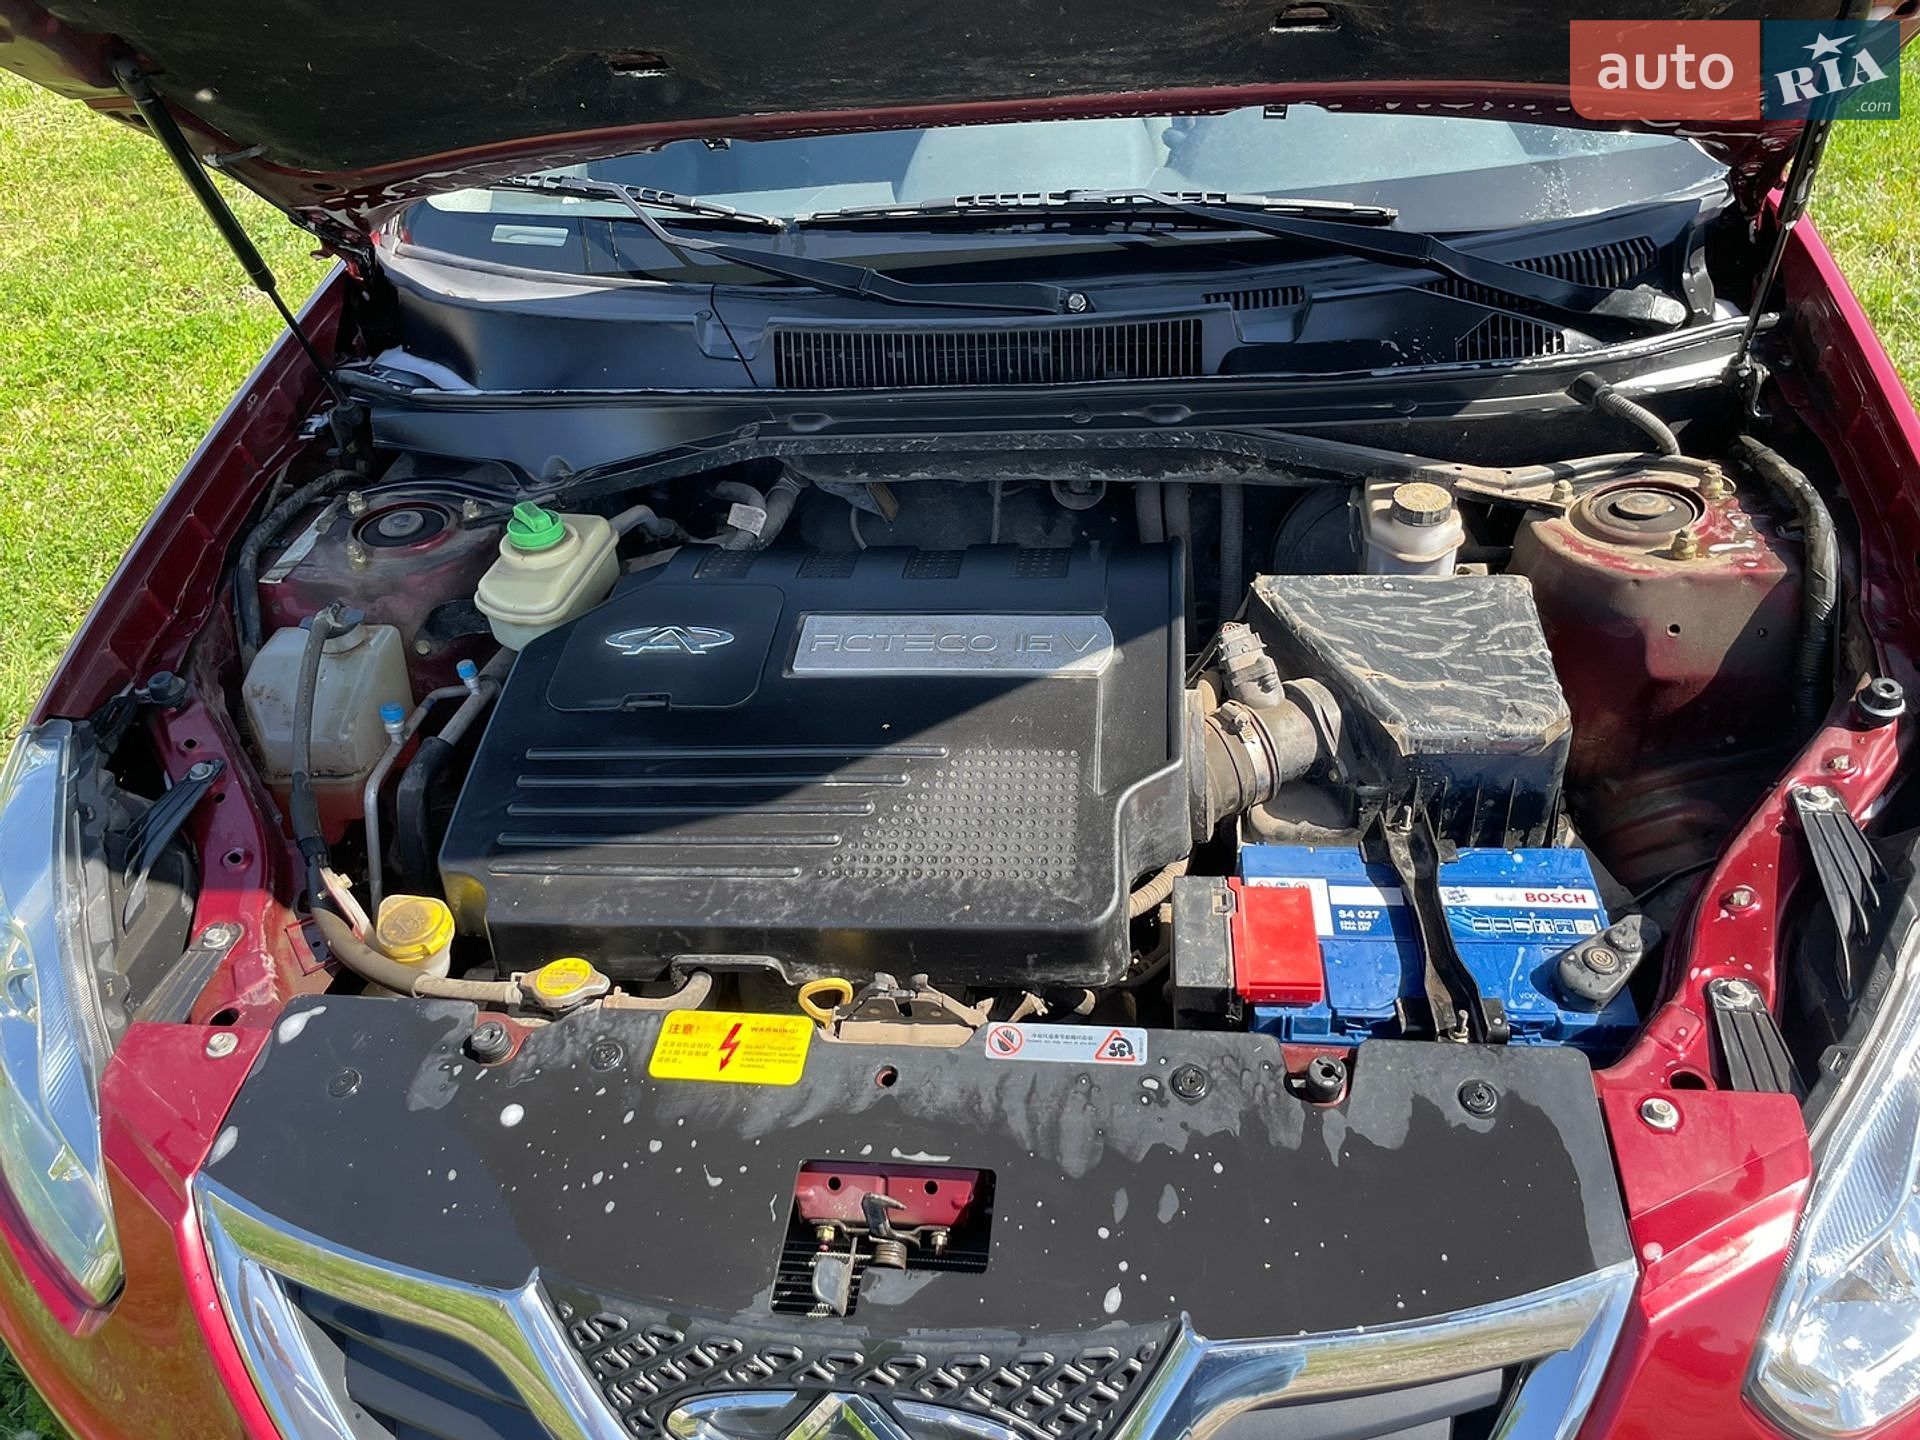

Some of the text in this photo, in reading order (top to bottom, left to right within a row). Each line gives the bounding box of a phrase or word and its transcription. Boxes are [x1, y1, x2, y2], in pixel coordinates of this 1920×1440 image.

[810, 633, 999, 653] ACTECO
[1525, 892, 1587, 904] BOSCH
[1357, 910, 1380, 920] 027
